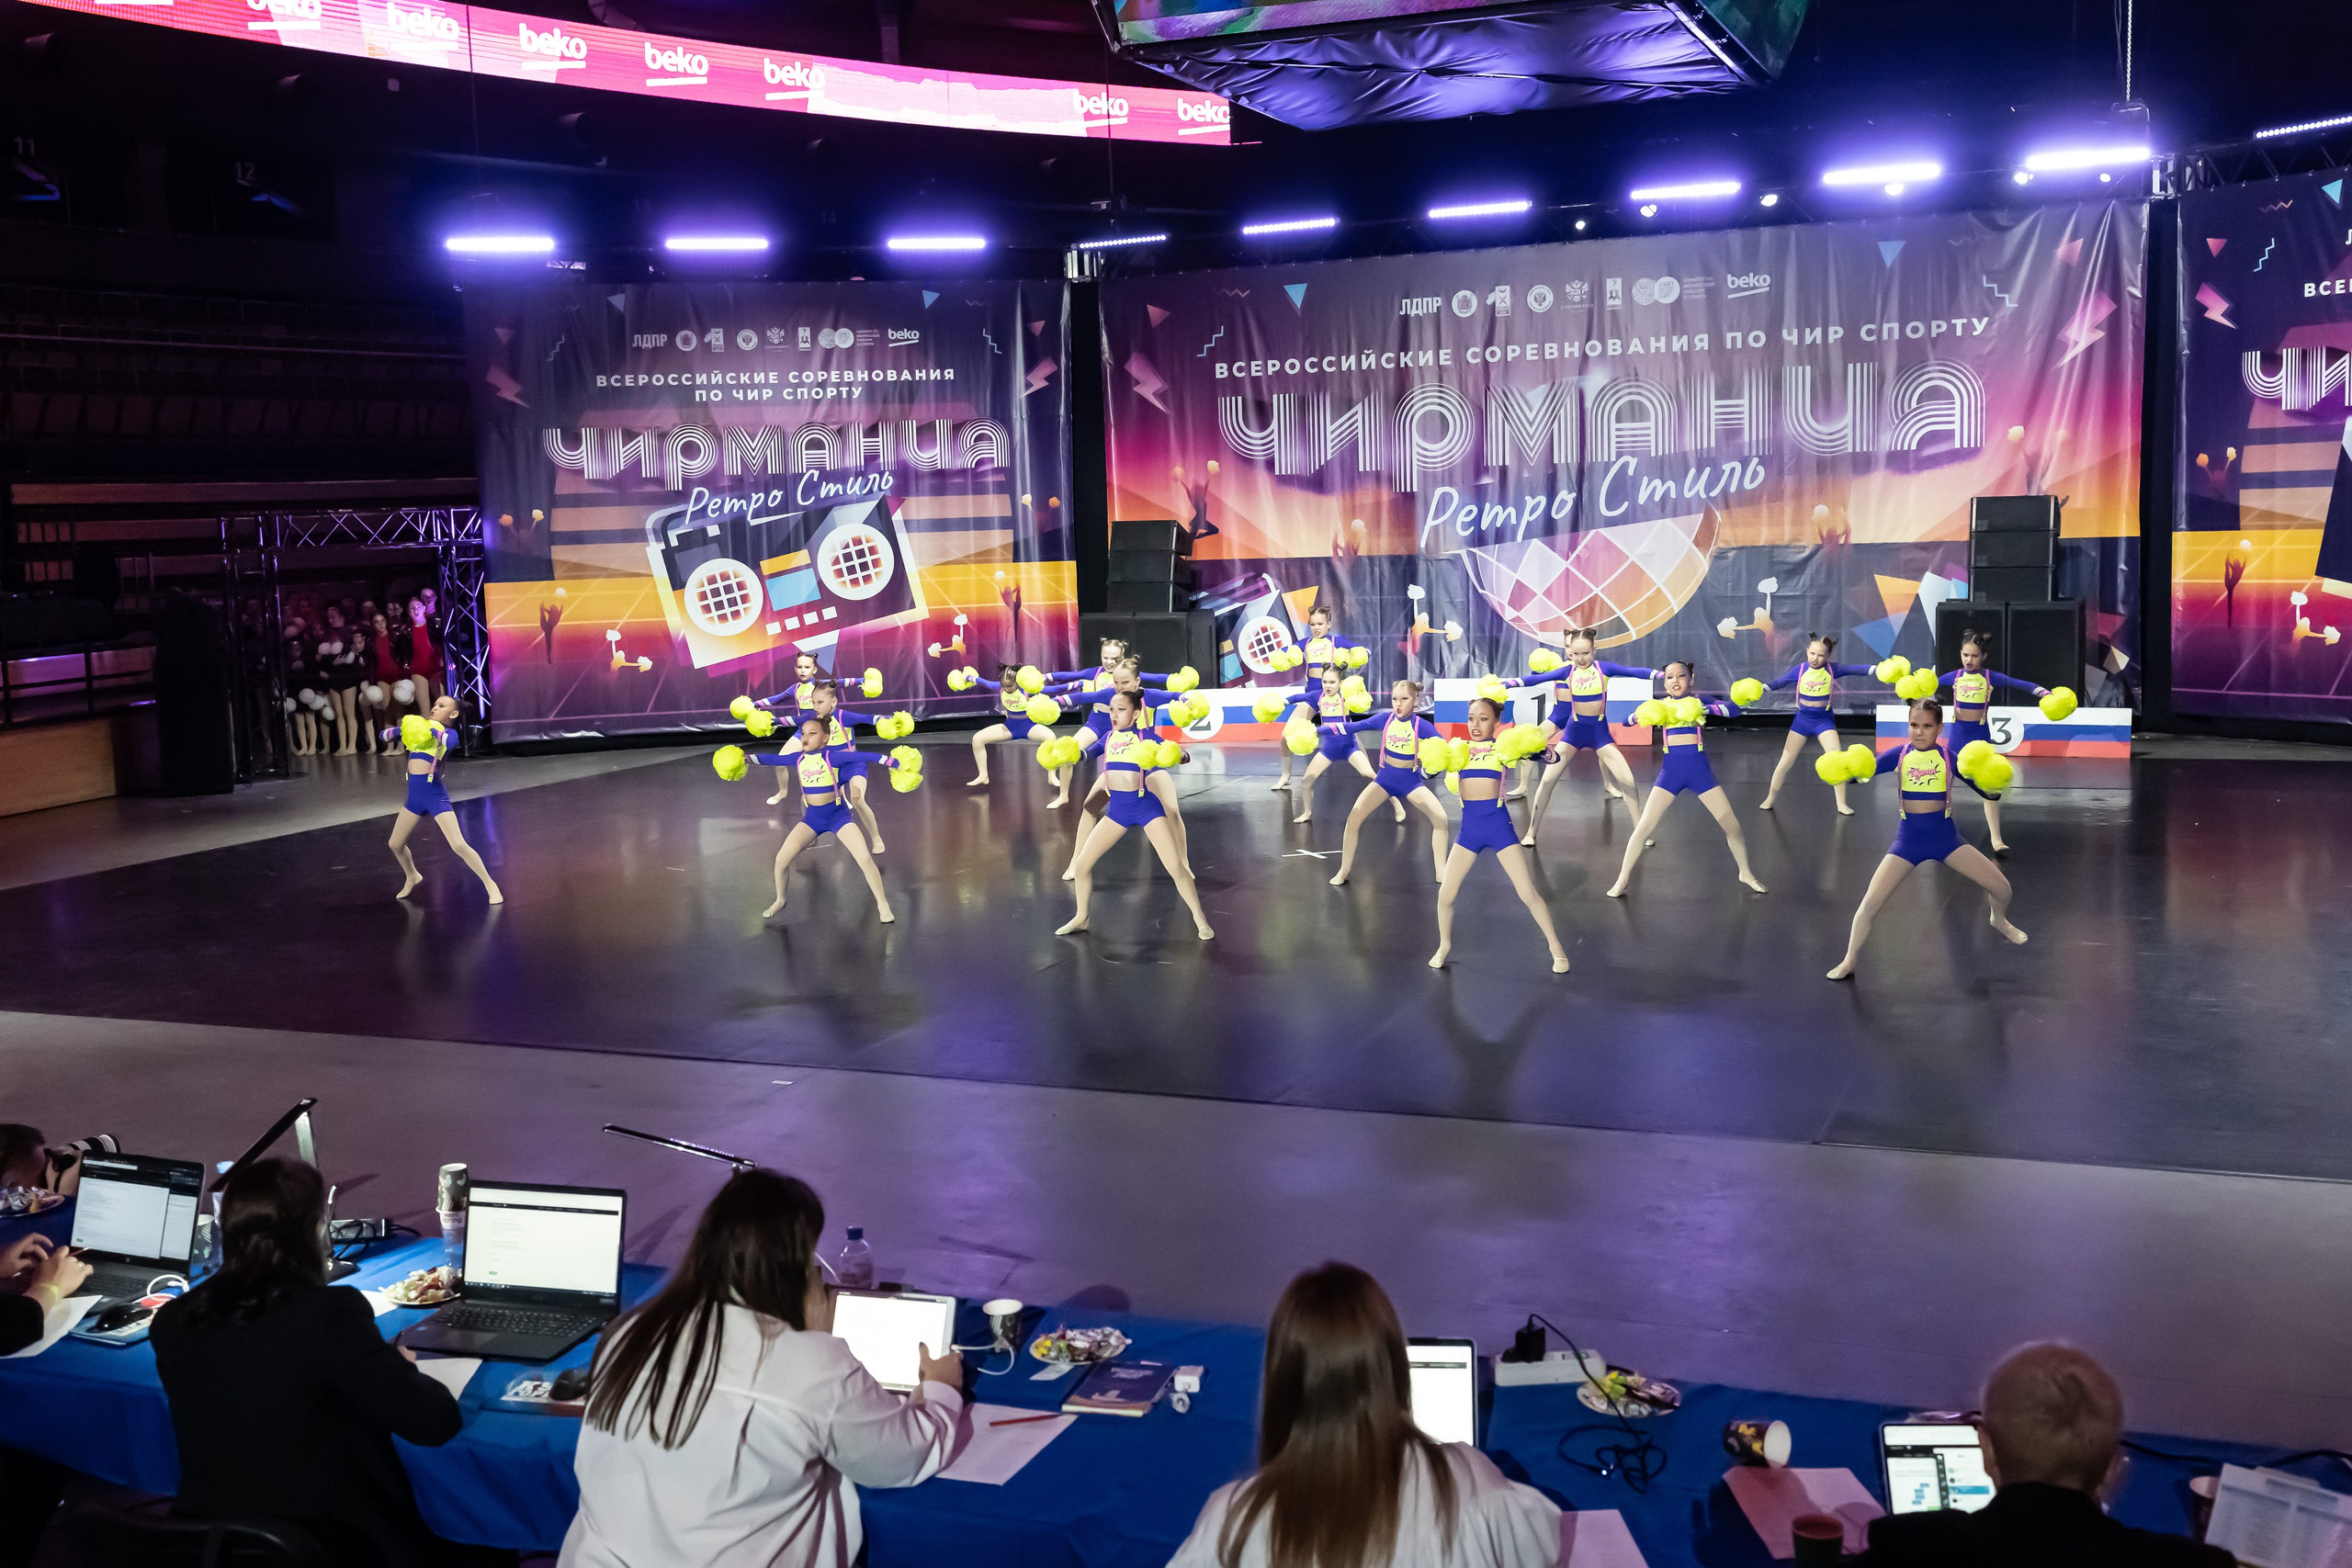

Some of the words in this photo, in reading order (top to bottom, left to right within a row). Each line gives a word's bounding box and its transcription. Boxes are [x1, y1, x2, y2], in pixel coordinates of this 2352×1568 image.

[387, 2, 458, 40] beko
[519, 23, 587, 60] beko
[644, 41, 709, 75] beko
[763, 58, 825, 90] beko
[1073, 91, 1129, 116] beko
[14, 134, 35, 156] 11
[234, 161, 255, 180] 12
[1727, 273, 1771, 288] beko
[2304, 279, 2352, 298] ВСЕ
[1399, 296, 1442, 317] ЛДПР
[632, 334, 668, 349] ЛДПР
[888, 329, 920, 340] beko
[1215, 348, 1453, 378] ВСЕРОССИЙСКИЕ
[1466, 333, 1711, 365] СОРЕВНОВАНИЯ
[1725, 330, 1768, 350] ПО
[1783, 324, 1844, 344] ЧИР
[1860, 316, 1990, 343] СПОРТУ
[596, 370, 779, 387] ВСЕРОССИЙСКИЕ
[789, 367, 956, 383] СОРЕВНОВАНИЯ
[695, 389, 723, 401] ПО
[733, 388, 774, 401] ЧИР
[783, 386, 864, 400] СПОРТУ
[684, 487, 783, 525] Ретро
[797, 468, 894, 506] Стиль
[1419, 486, 1577, 548] Ретро
[1598, 456, 1766, 517] Стиль
[1531, 693, 1546, 726] 1
[1990, 717, 2012, 745] 3
